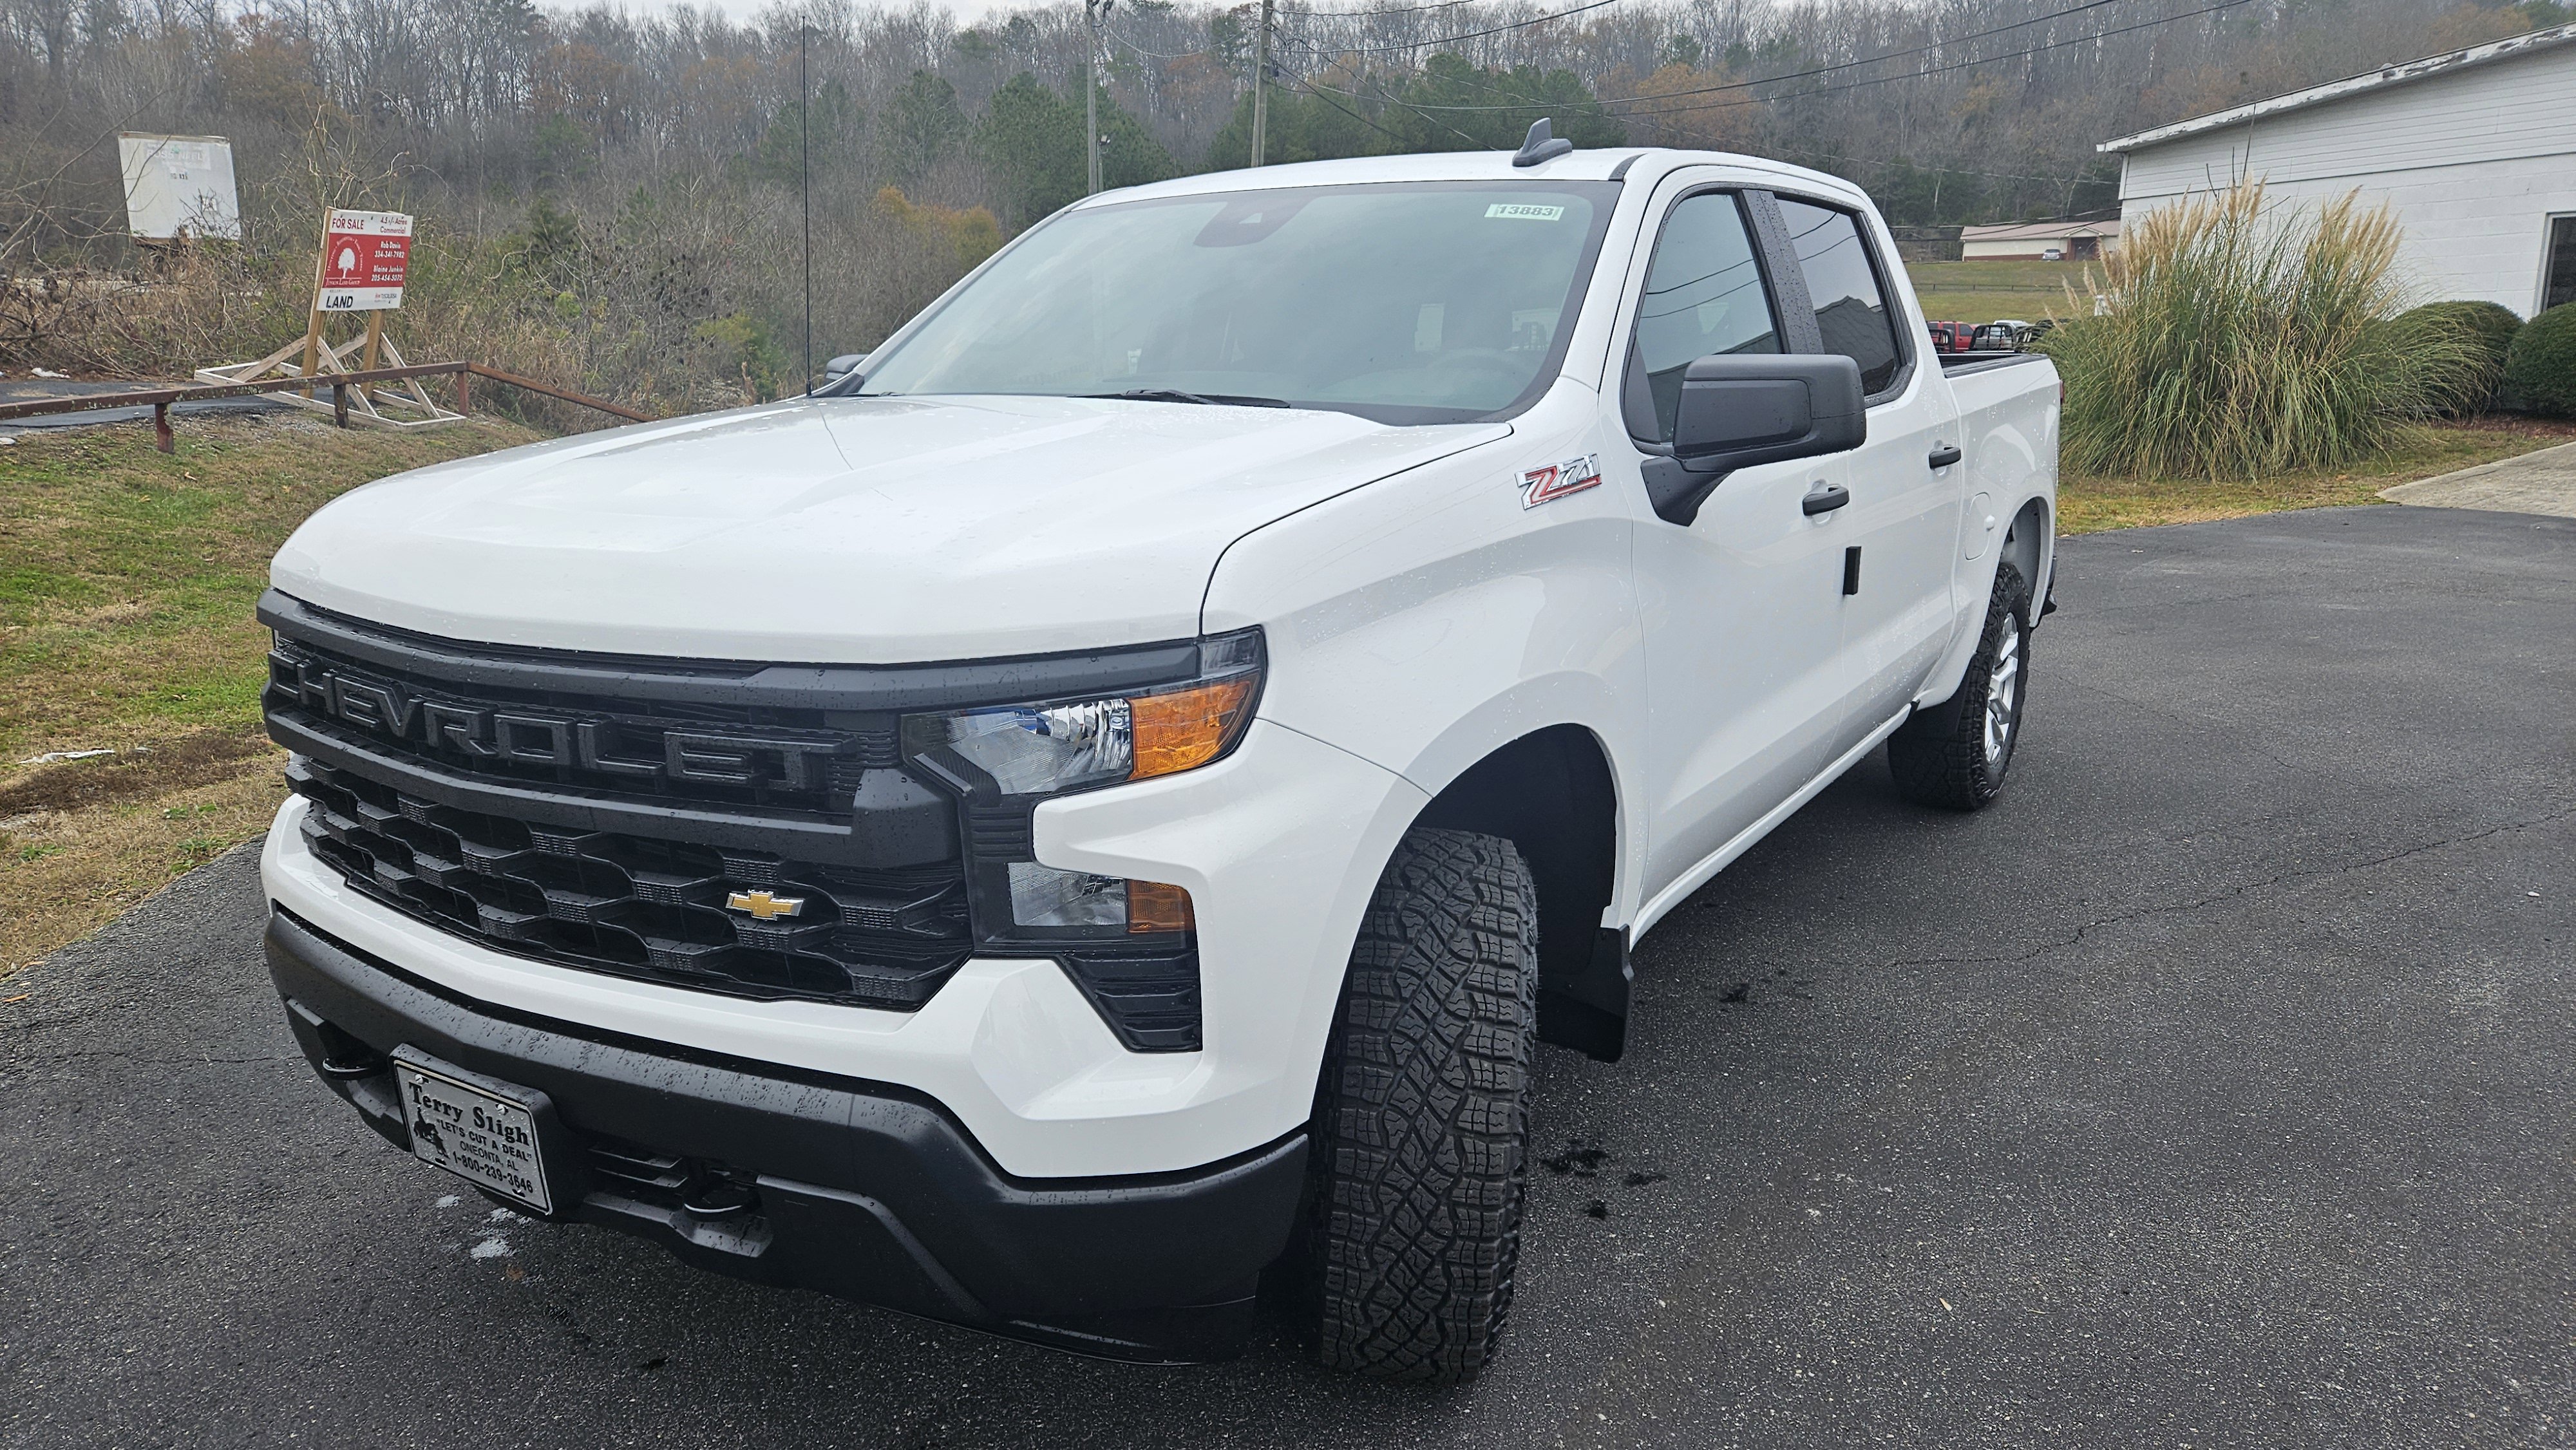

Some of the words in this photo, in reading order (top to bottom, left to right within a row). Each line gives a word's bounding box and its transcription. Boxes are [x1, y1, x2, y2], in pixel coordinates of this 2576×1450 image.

[332, 218, 346, 229] FOR
[347, 219, 364, 230] SALE
[1498, 205, 1555, 216] 13883
[326, 296, 354, 308] LAND
[1515, 453, 1602, 510] Z71
[268, 648, 860, 791] CHEVROLET
[408, 1081, 463, 1122] Terry
[473, 1106, 530, 1146] Sligh
[460, 1141, 504, 1167] ONEONTA,
[507, 1160, 519, 1171] AL
[469, 1131, 487, 1145] CUT
[491, 1140, 498, 1151] A
[452, 1151, 534, 1193] 1-800-239-3646
